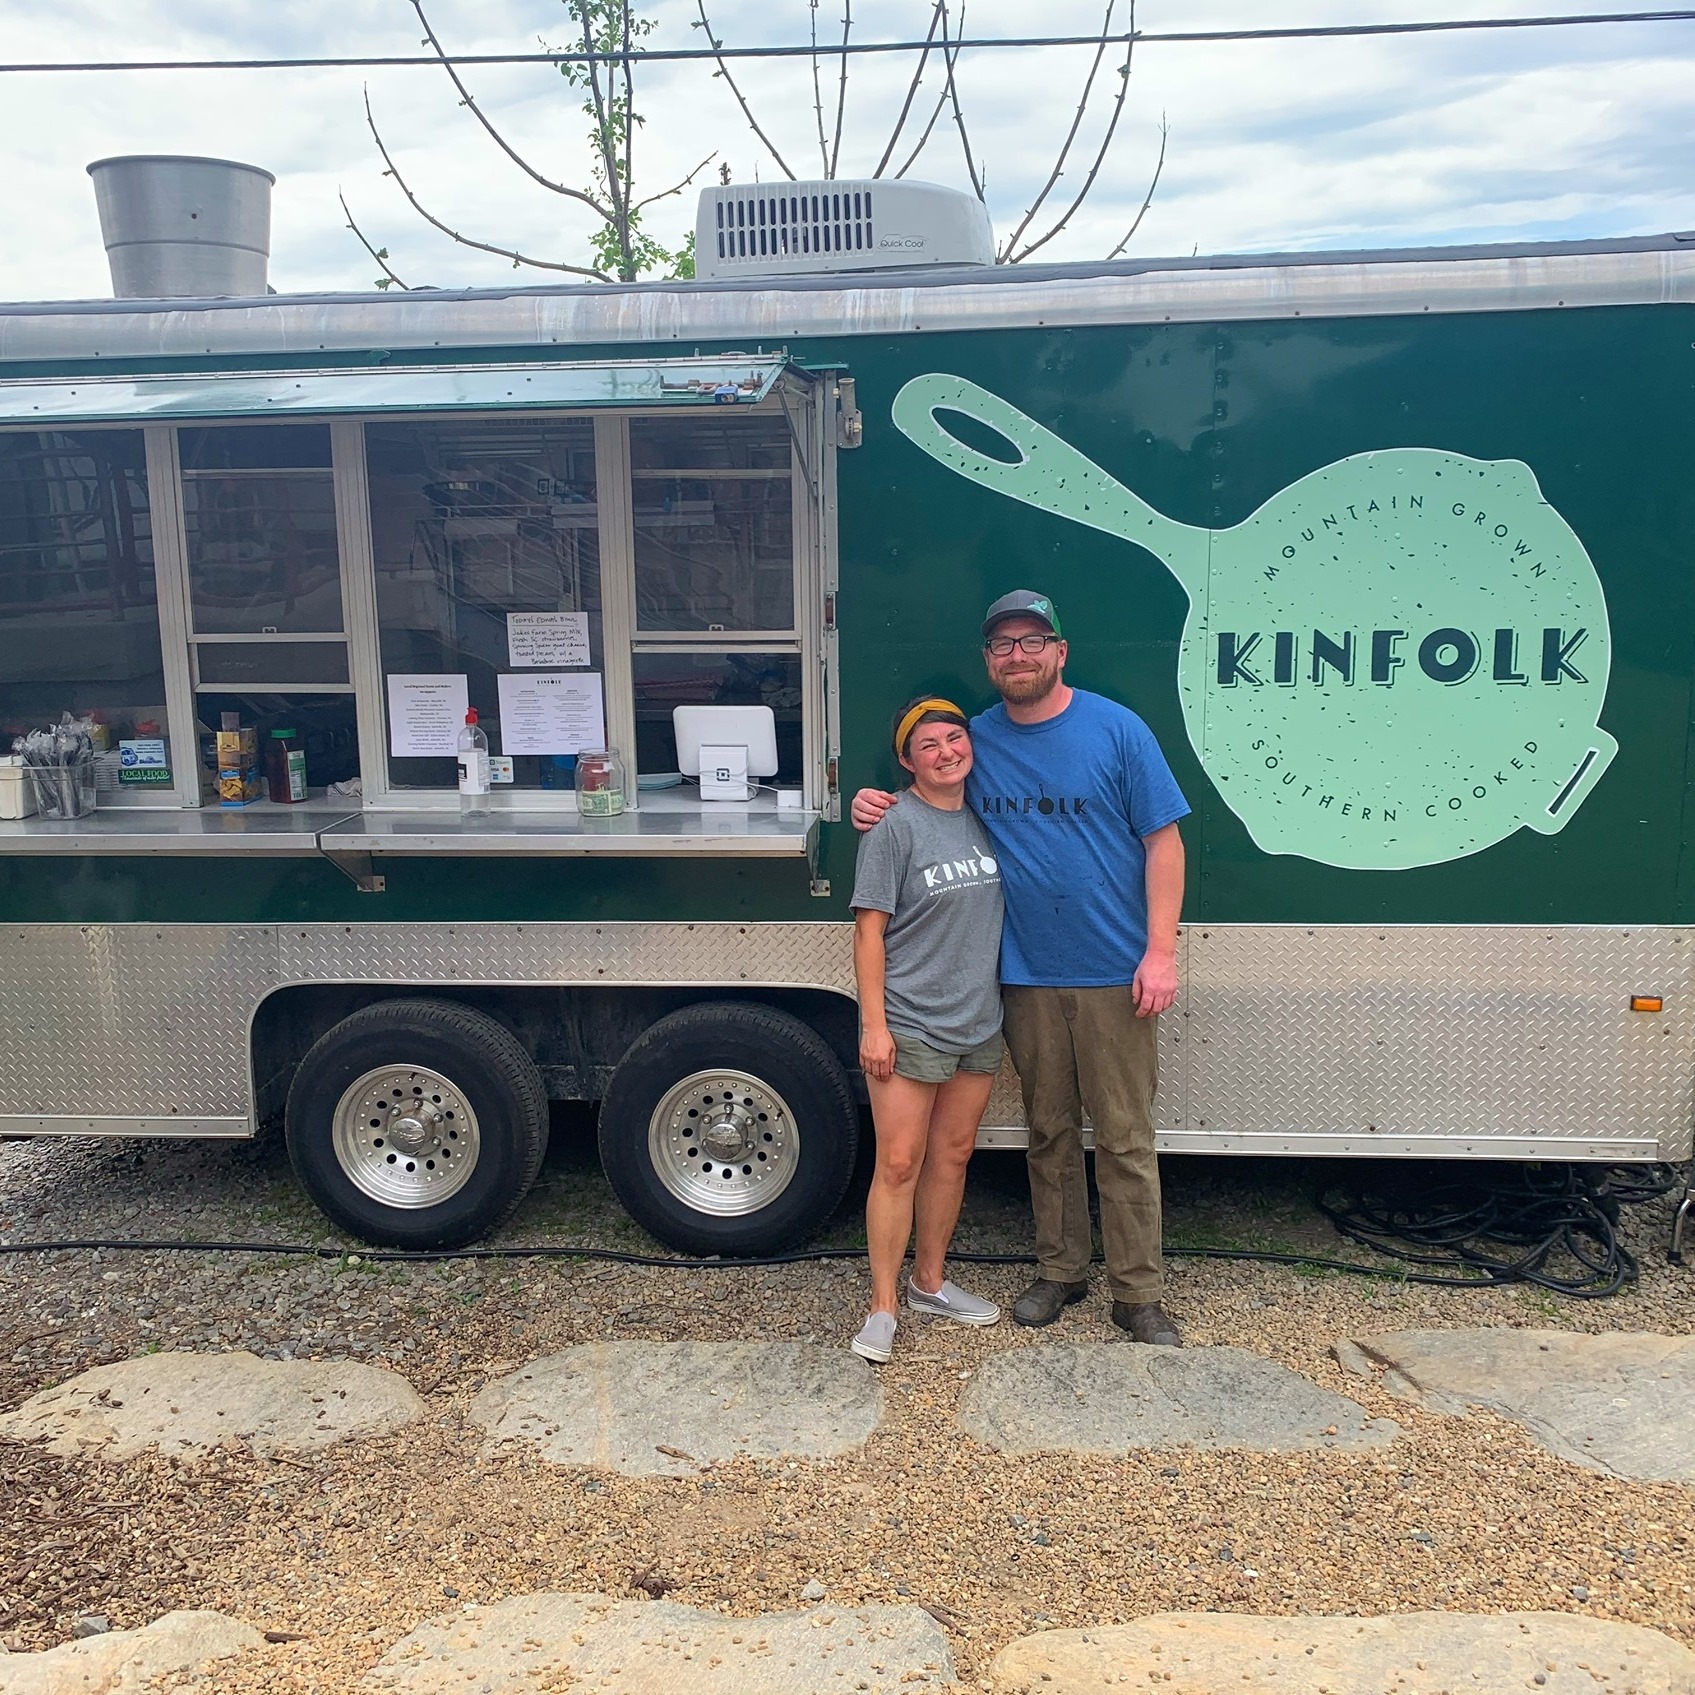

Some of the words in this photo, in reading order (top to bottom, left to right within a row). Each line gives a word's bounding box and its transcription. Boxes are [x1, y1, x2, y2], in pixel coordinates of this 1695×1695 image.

[880, 239, 903, 247] Quick
[904, 239, 924, 248] Cool
[1263, 495, 1423, 581] MOUNTAIN
[1452, 502, 1548, 578] GROWN
[1217, 627, 1590, 687] KINFOLK
[1251, 739, 1396, 822] SOUTHERN
[1425, 741, 1539, 818] COOKED
[982, 791, 1088, 815] KINFOLK
[923, 849, 998, 888] KINFO
[929, 883, 962, 897] MOUNTAIN
